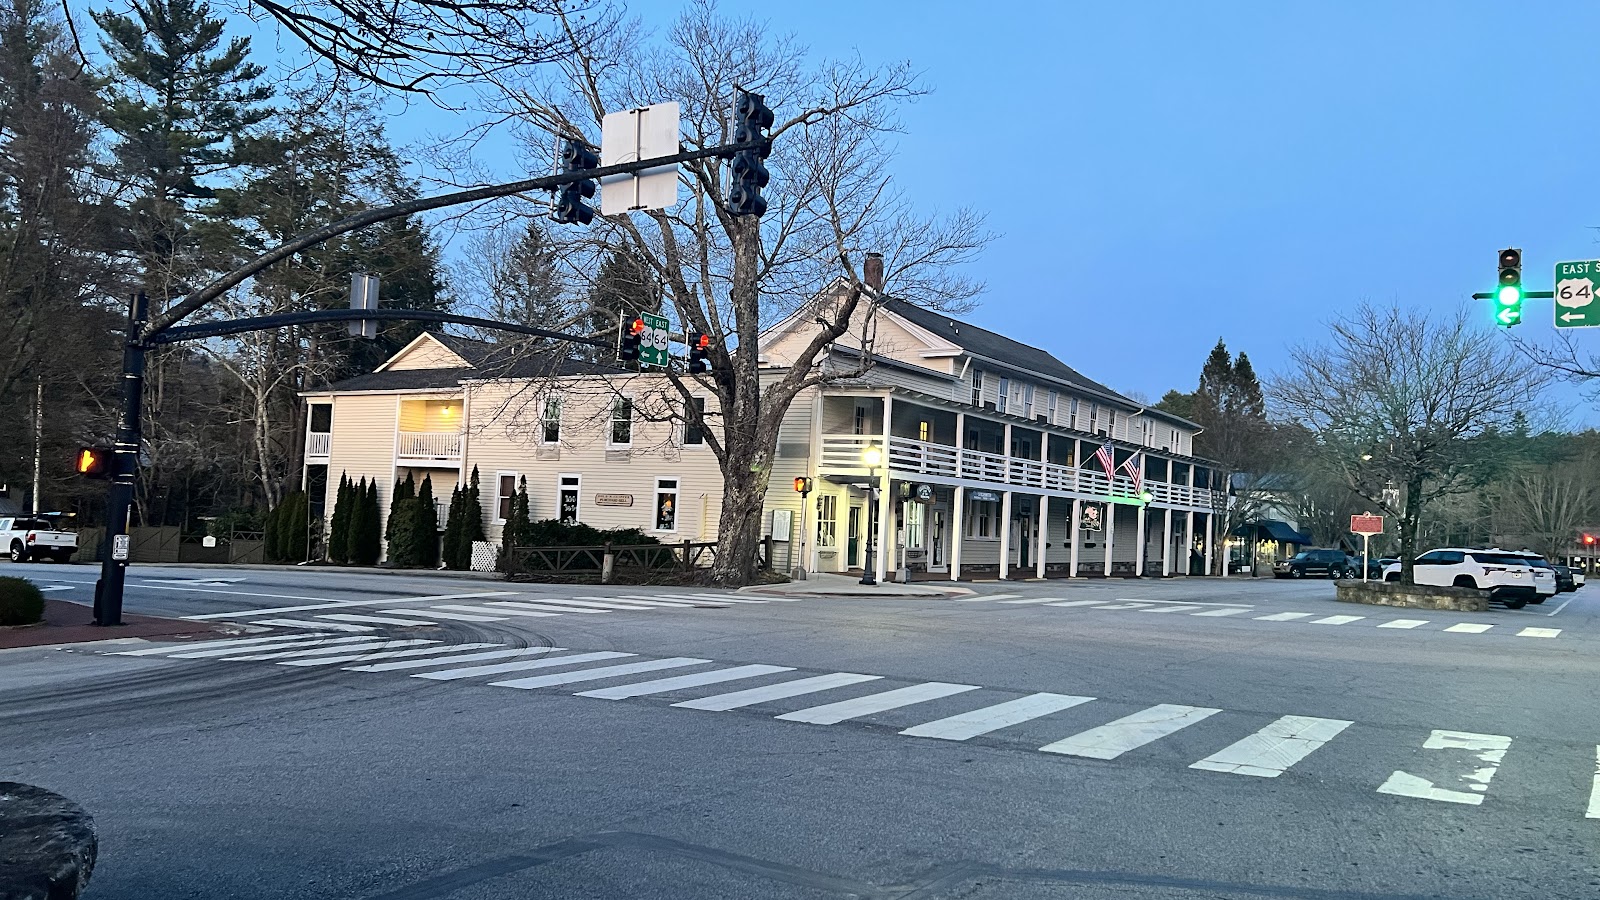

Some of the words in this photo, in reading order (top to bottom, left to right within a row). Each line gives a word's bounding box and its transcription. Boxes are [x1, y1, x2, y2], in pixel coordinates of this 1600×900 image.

[1563, 264, 1590, 274] EAST
[1560, 285, 1590, 299] 64
[656, 320, 667, 328] EAST
[641, 331, 652, 342] 64
[654, 334, 667, 346] 64
